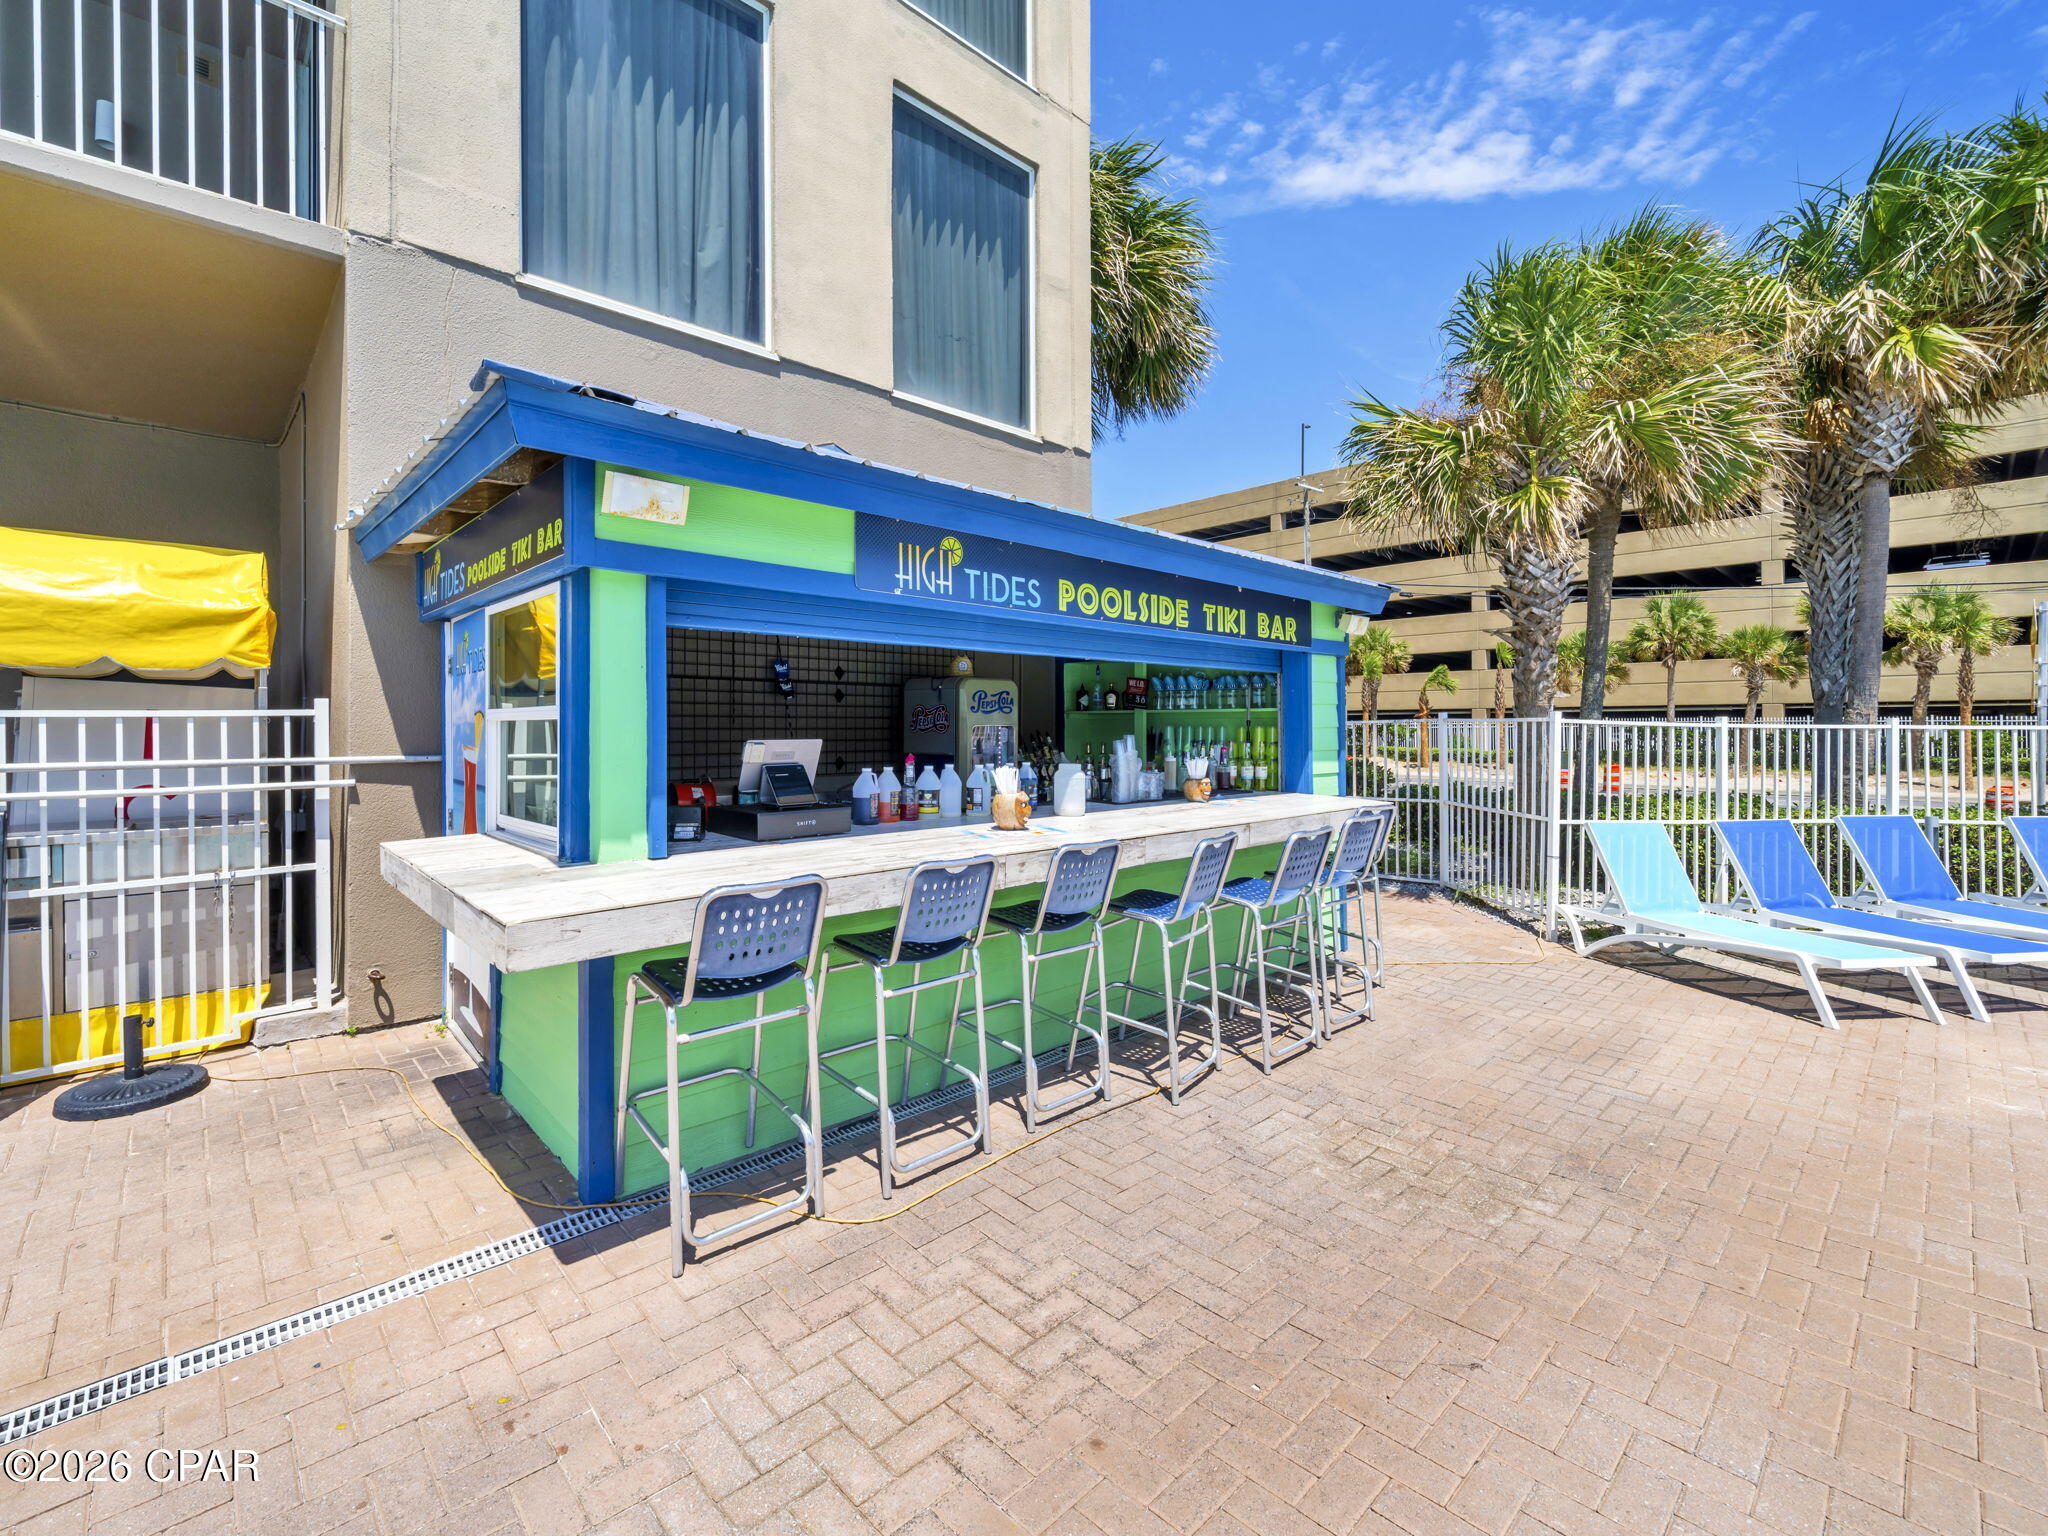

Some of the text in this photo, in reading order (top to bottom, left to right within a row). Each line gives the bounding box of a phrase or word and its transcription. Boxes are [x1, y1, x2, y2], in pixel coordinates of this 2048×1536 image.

[440, 562, 465, 600] TIDES
[466, 547, 507, 587] POOLSIDE
[511, 533, 533, 567] TIKI
[536, 518, 563, 555] BAR
[895, 542, 1298, 643] HIGH TIDES POOLSIDE TIKI BAR
